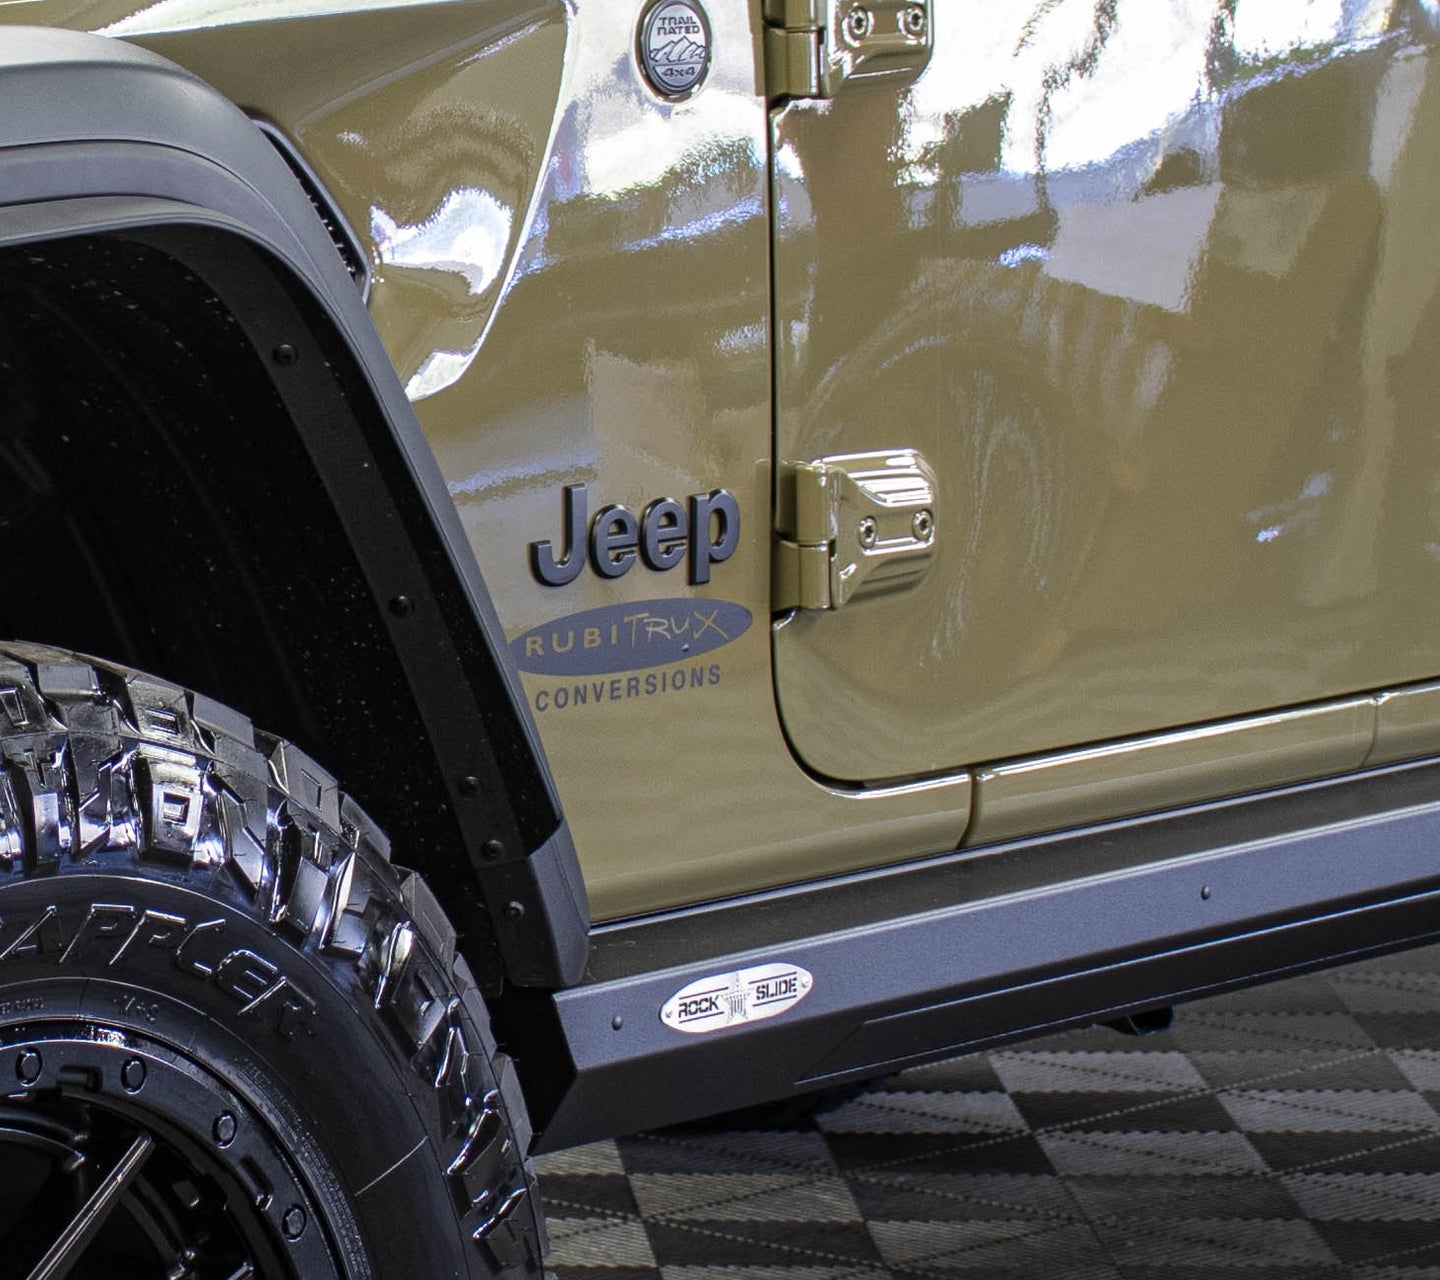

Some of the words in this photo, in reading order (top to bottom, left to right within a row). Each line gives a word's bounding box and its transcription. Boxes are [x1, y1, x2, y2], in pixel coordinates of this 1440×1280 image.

[656, 25, 700, 36] RATED
[658, 16, 697, 27] TRAIL
[530, 482, 740, 587] Jeep
[525, 610, 729, 657] RUBITRUX
[535, 664, 722, 712] CONVERSIONS
[678, 995, 720, 1018] ROCK
[755, 977, 797, 1000] SLIDE
